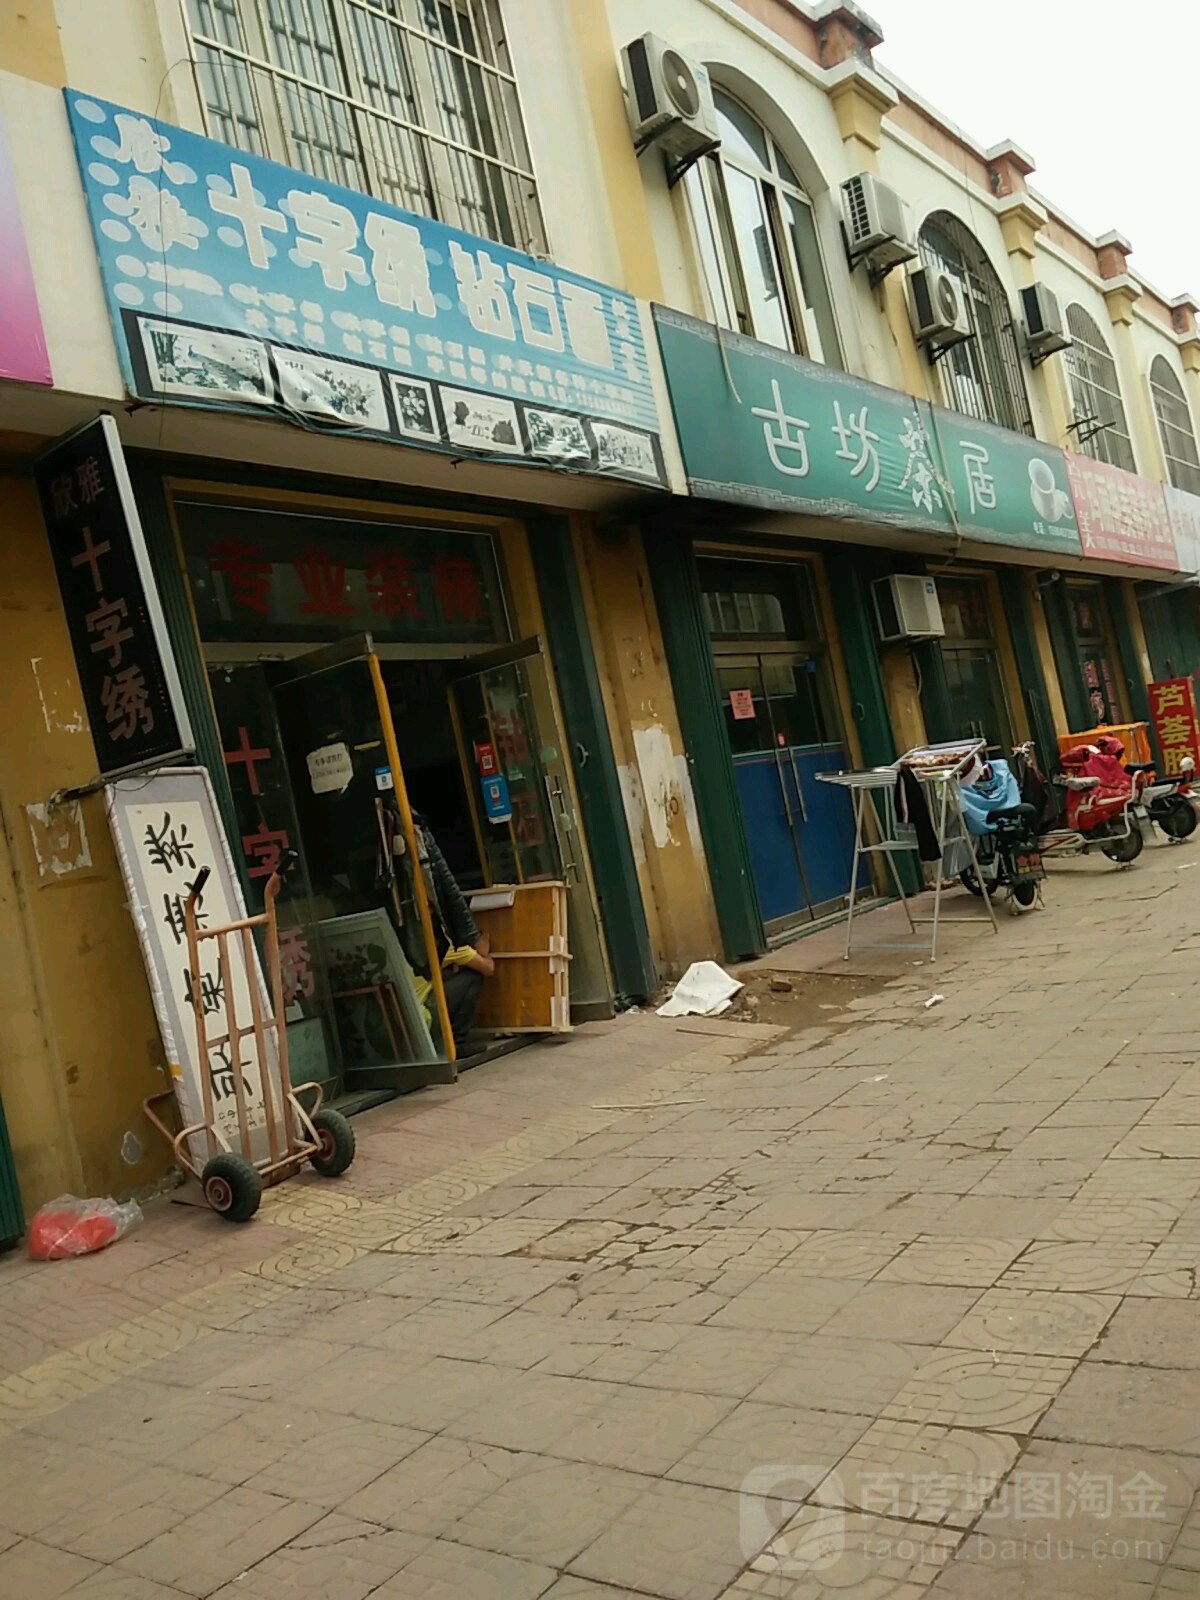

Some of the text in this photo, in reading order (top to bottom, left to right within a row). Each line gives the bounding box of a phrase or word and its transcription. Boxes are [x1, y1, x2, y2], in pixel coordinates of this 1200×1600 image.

[207, 162, 437, 318] 十字绣
[50, 456, 105, 522] 欣雅
[751, 377, 998, 516] 古坊茶居
[71, 526, 155, 743] 十字绣
